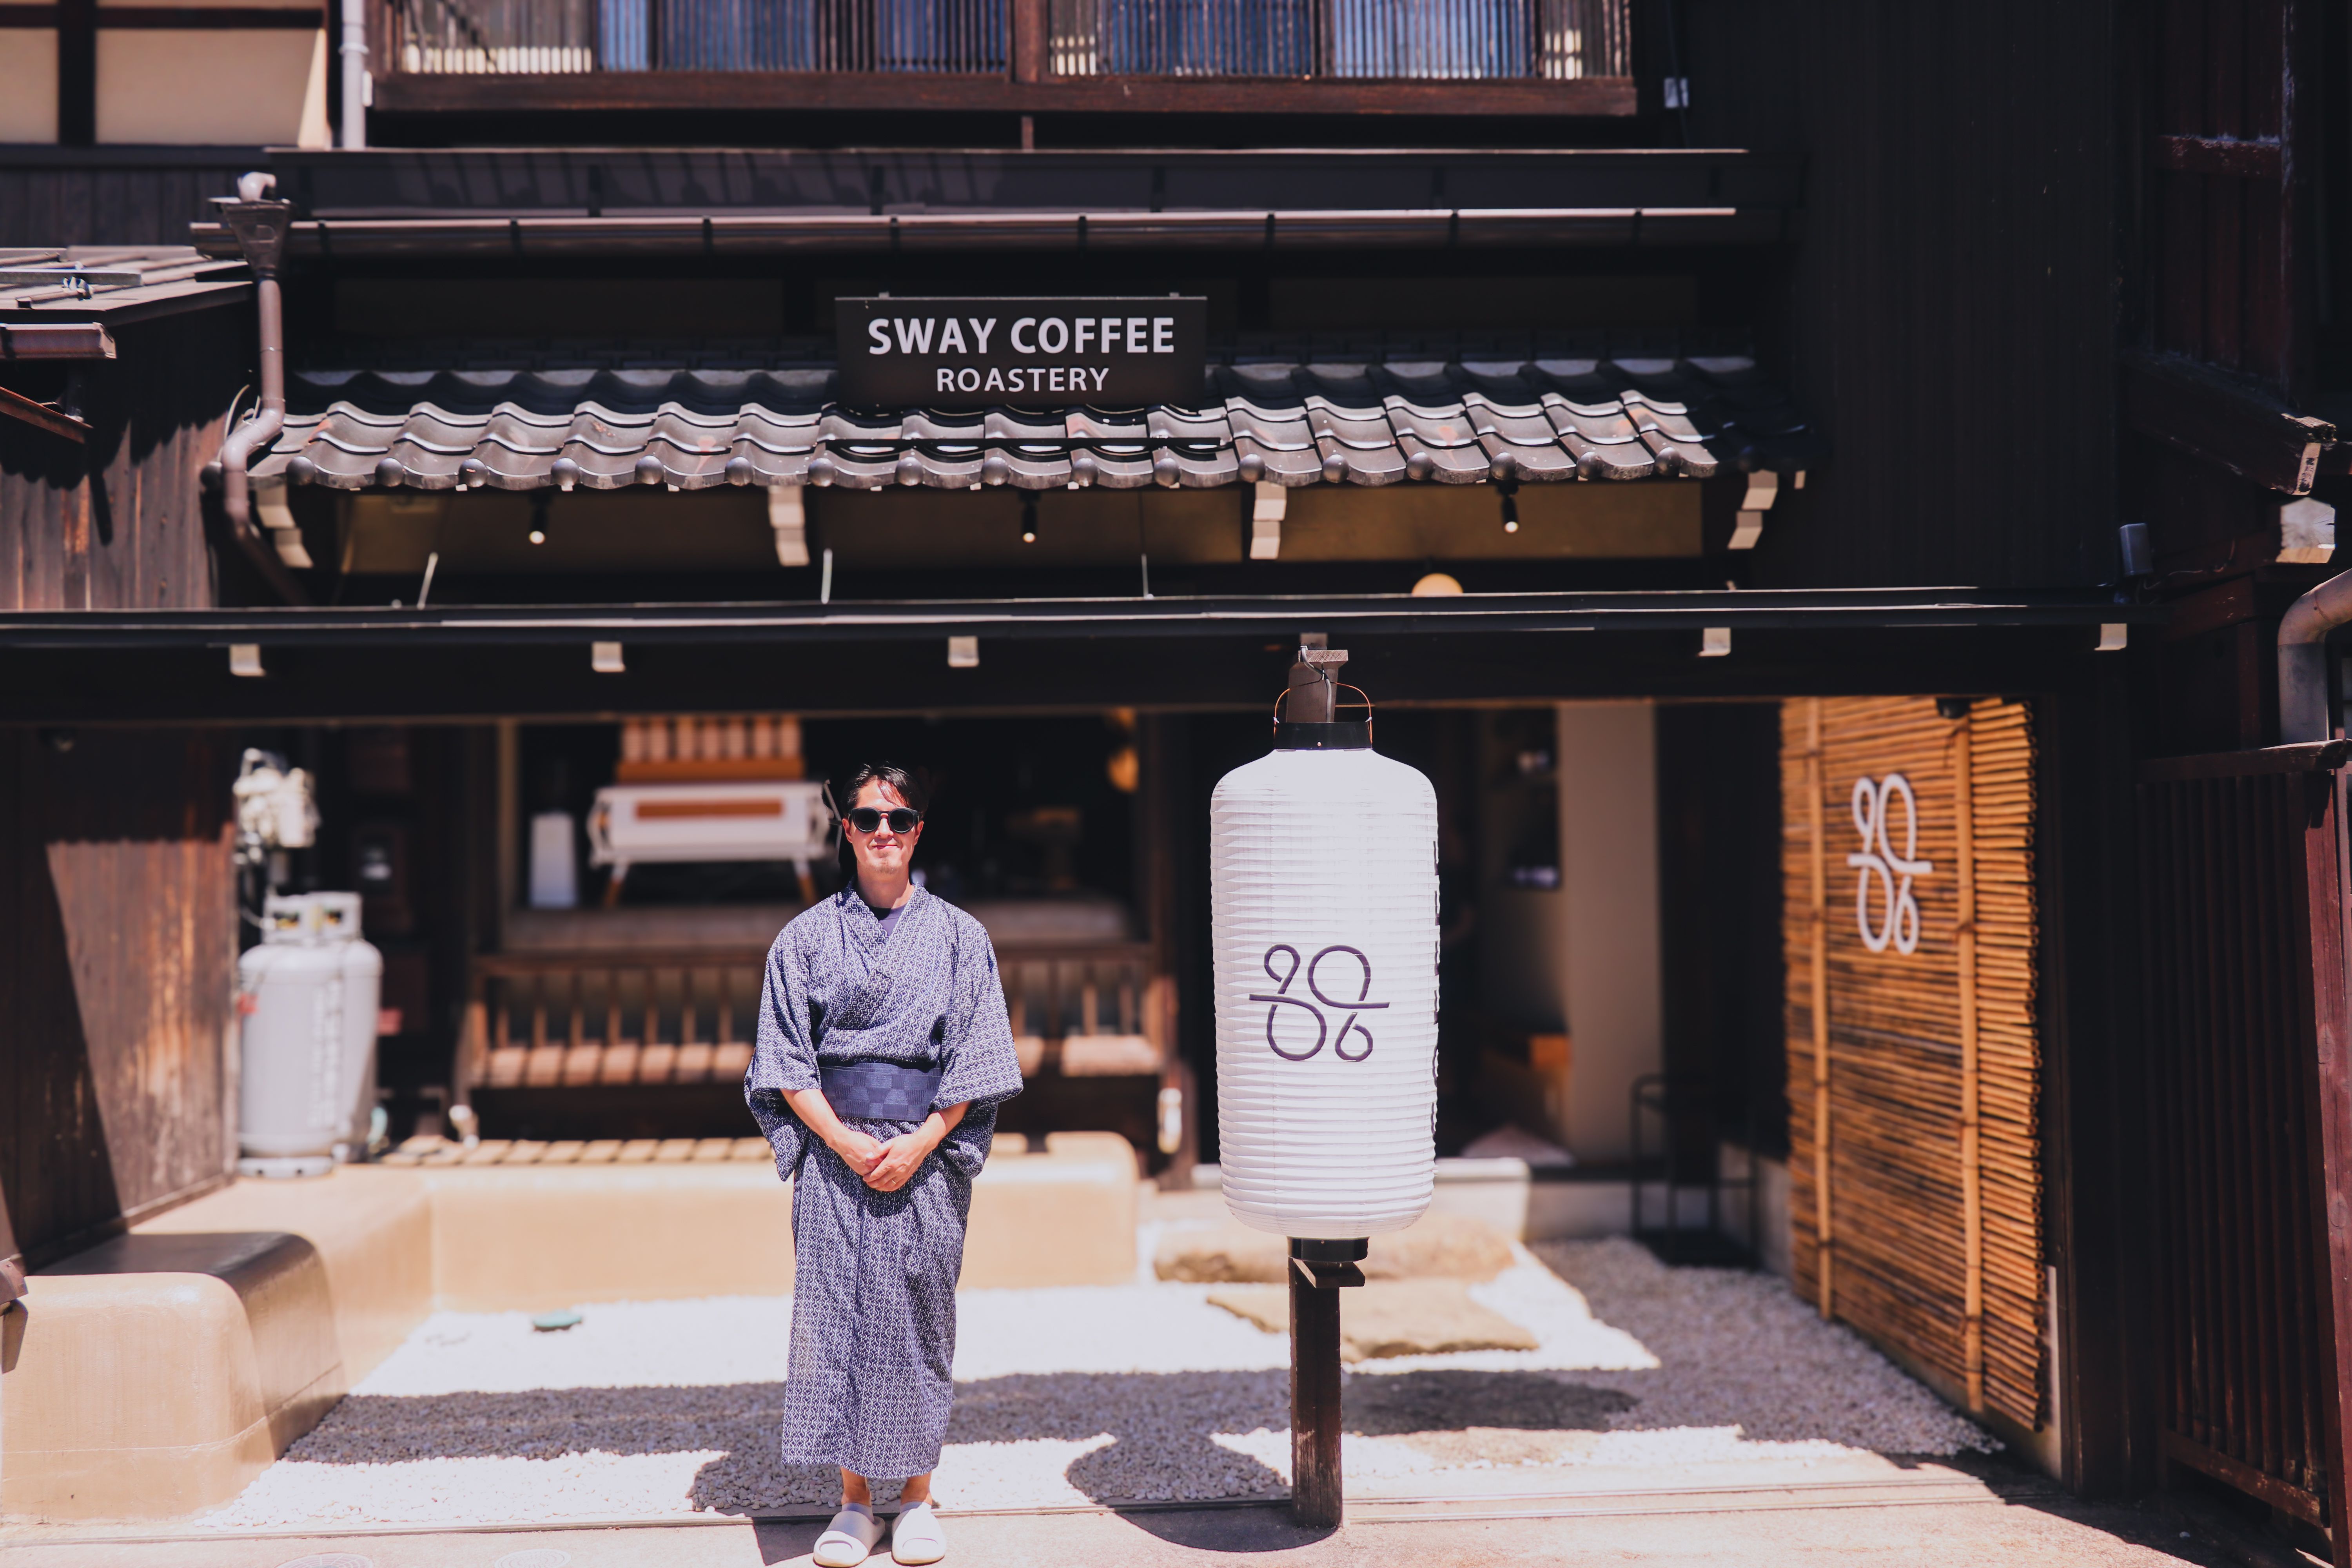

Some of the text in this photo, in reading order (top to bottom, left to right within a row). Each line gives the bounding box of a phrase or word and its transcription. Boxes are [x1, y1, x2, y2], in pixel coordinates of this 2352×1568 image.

[868, 317, 1174, 355] SWAY COFFEE
[936, 367, 1109, 392] ROASTERY
